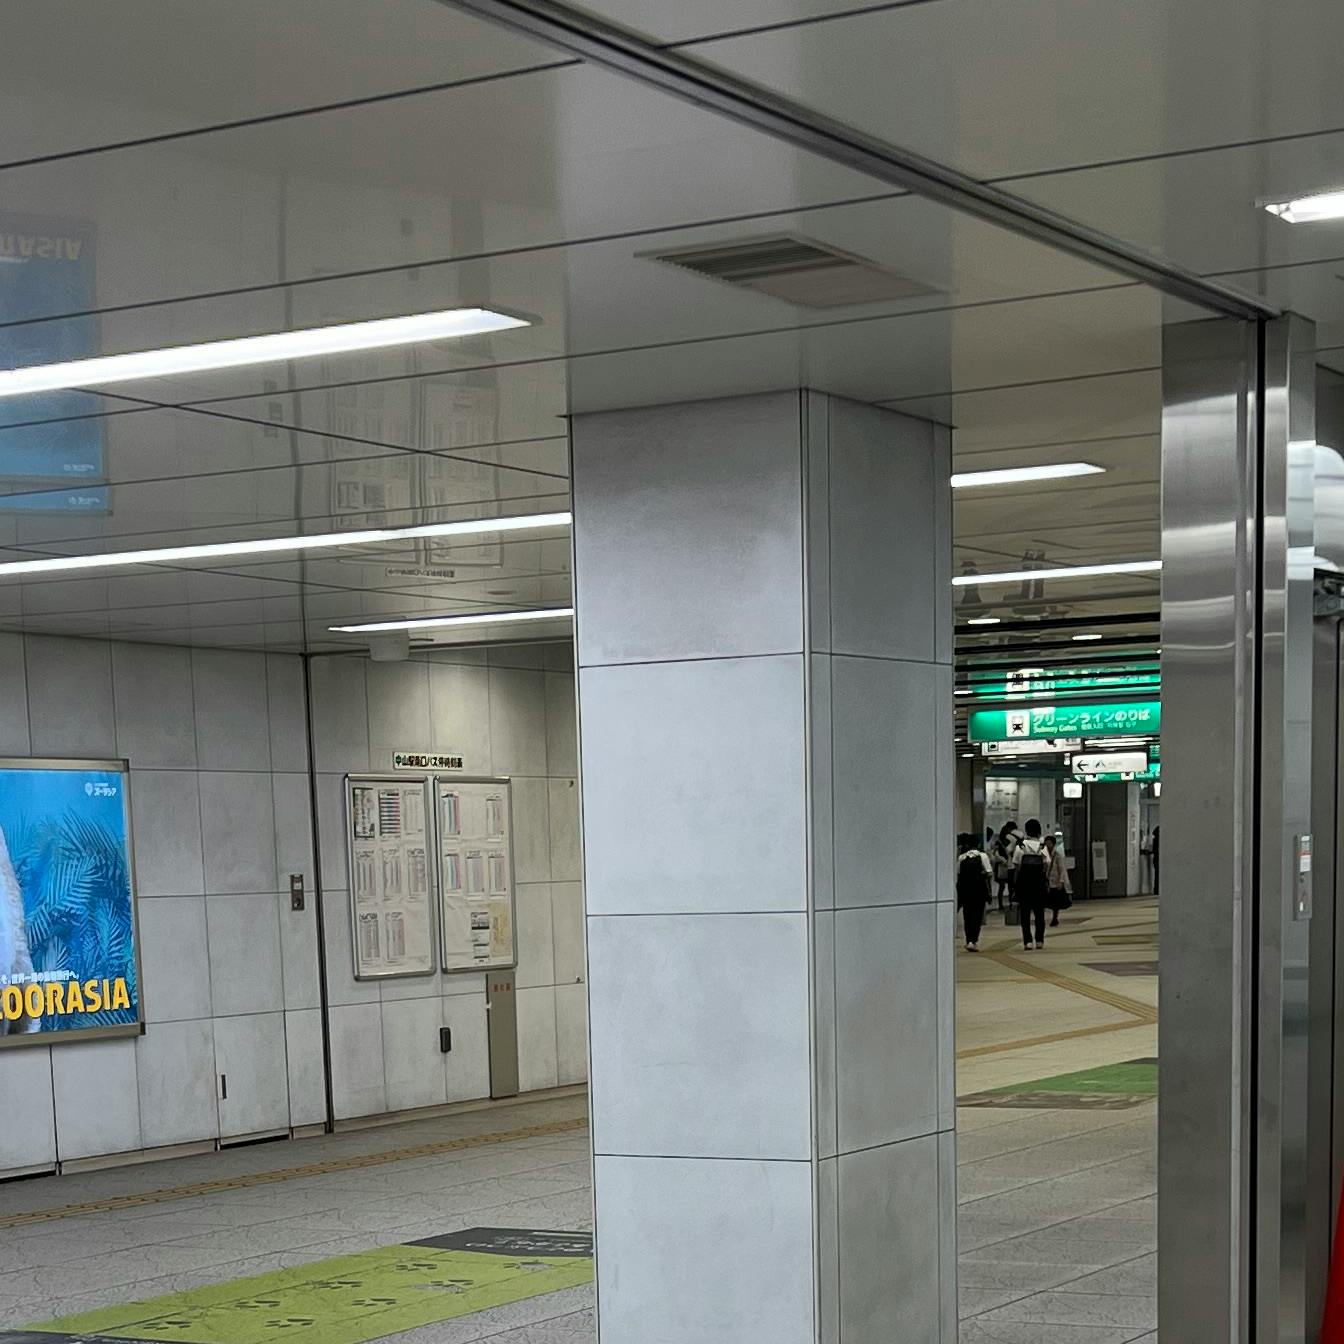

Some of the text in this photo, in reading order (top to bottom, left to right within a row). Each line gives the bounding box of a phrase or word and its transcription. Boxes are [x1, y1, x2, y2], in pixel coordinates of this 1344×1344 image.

[1033, 708, 1151, 726] グリーンラインのりば
